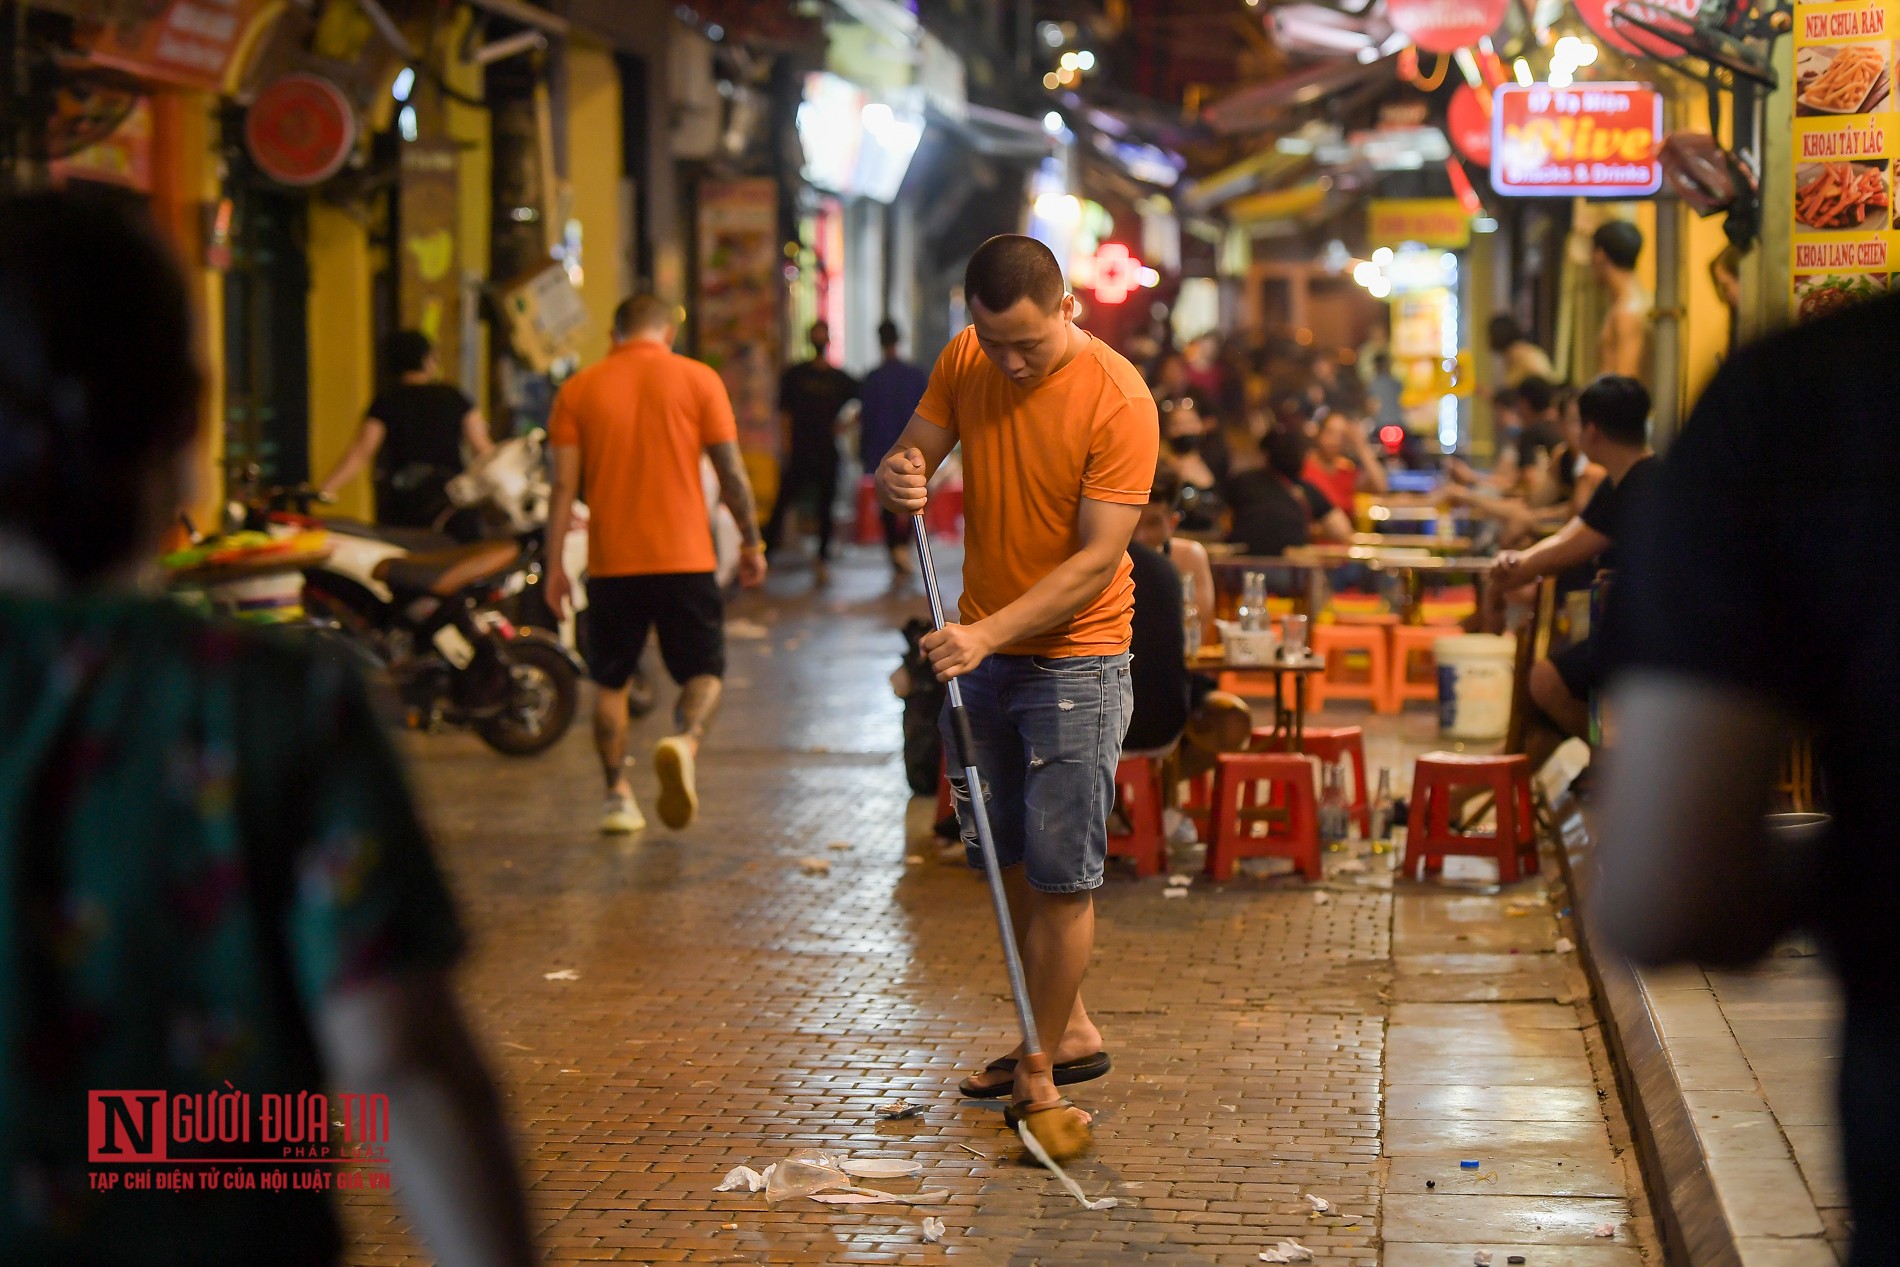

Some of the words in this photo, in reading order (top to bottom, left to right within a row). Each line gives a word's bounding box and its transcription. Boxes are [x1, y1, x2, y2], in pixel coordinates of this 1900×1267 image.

[1806, 14, 1827, 38] NEM
[1831, 12, 1858, 36] CHUA
[1862, 3, 1884, 34] RÁN
[1803, 133, 1837, 156] KHOAI
[1840, 125, 1860, 154] TÂY
[1863, 117, 1883, 153] LẮC
[1591, 163, 1651, 183] Drinks
[1796, 244, 1827, 267] KHOAI
[1829, 243, 1855, 266] LANG
[1858, 235, 1887, 265] CHIÊN
